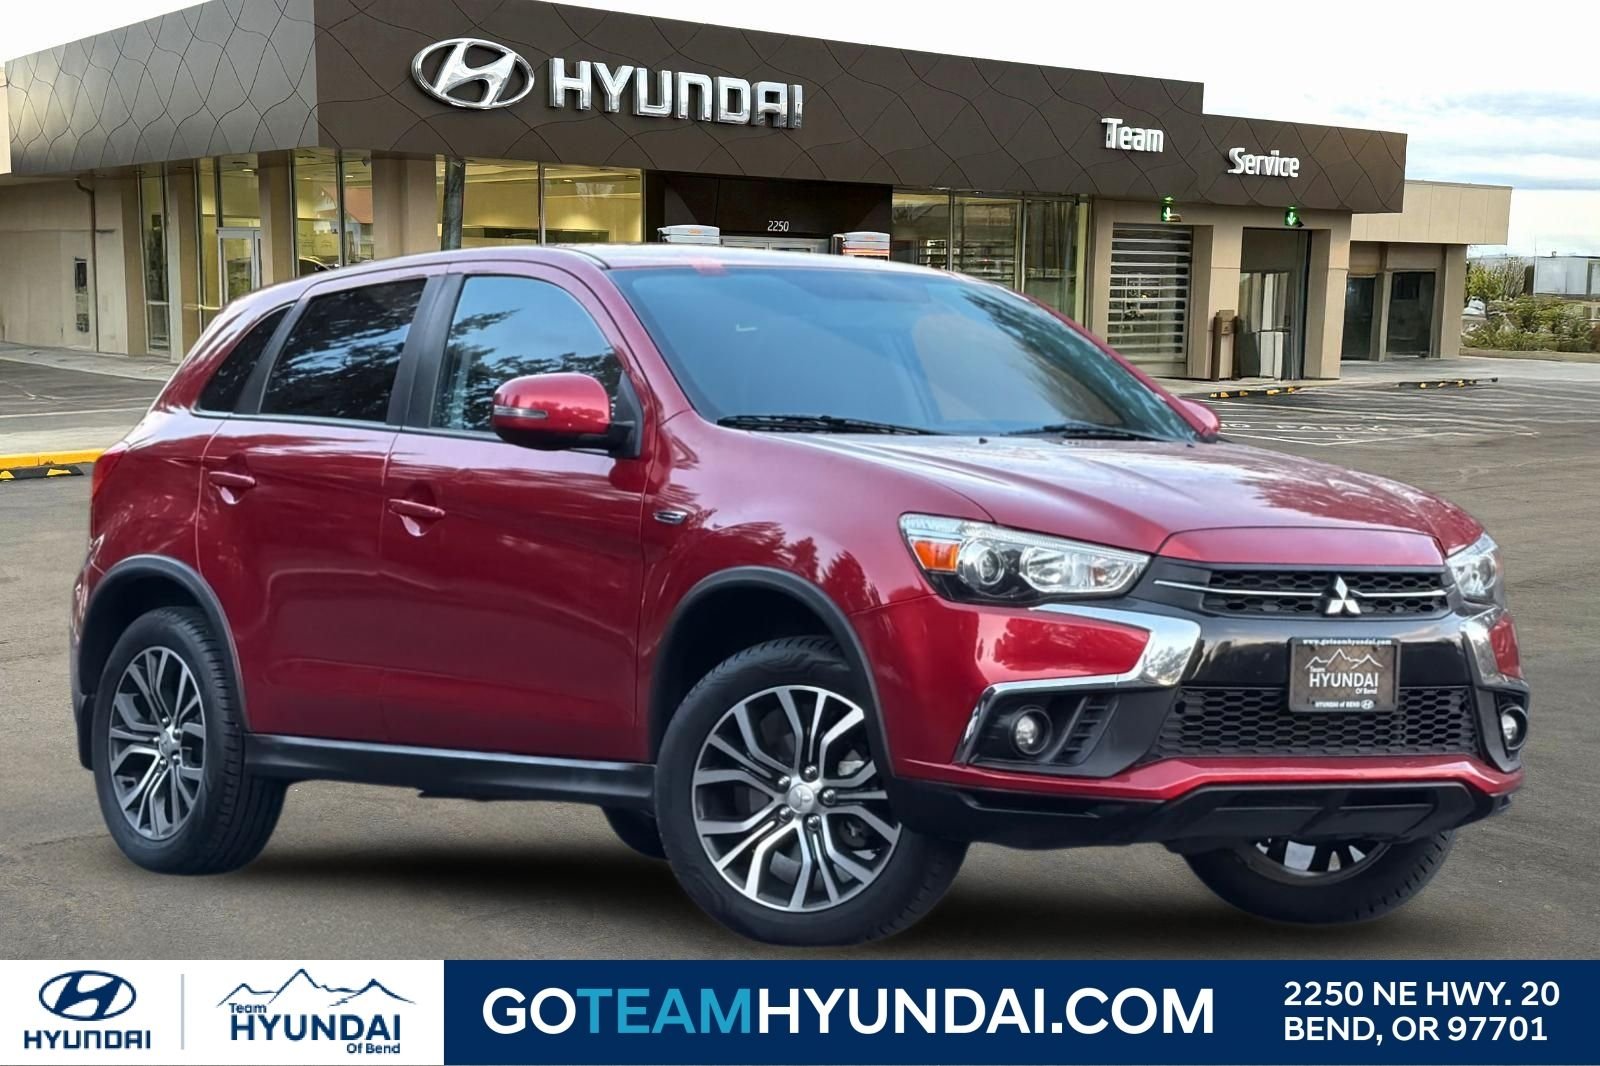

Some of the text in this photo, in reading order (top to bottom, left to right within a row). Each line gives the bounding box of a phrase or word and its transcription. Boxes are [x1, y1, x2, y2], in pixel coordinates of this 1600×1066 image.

[549, 57, 803, 129] HYUNDAI
[1101, 117, 1164, 152] Team
[1227, 147, 1299, 178] Service
[768, 220, 790, 232] 2250
[1309, 672, 1379, 688] HYUNDAI
[1355, 687, 1378, 695] Of Bend
